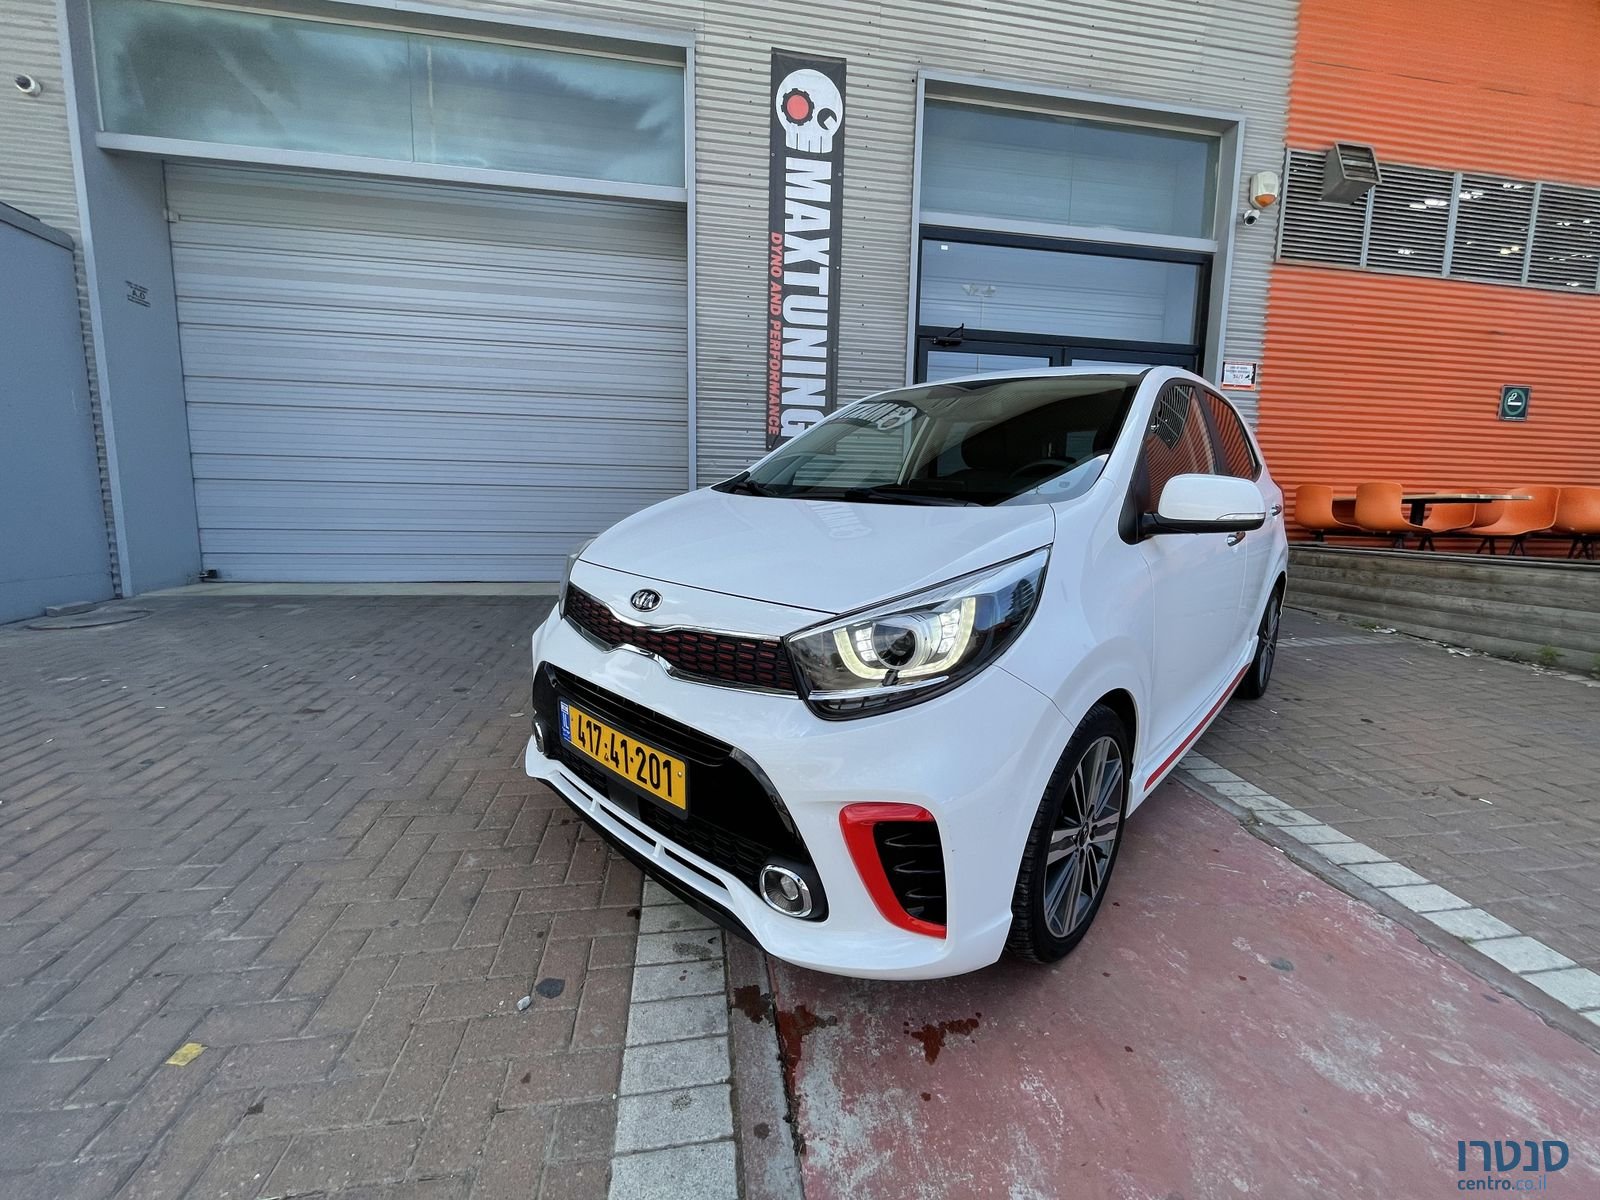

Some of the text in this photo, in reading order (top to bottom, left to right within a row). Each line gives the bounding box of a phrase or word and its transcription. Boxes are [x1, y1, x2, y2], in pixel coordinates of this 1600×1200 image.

[768, 231, 783, 436] DYNO AND PERFORMANCE
[780, 156, 831, 438] MAXTUNING
